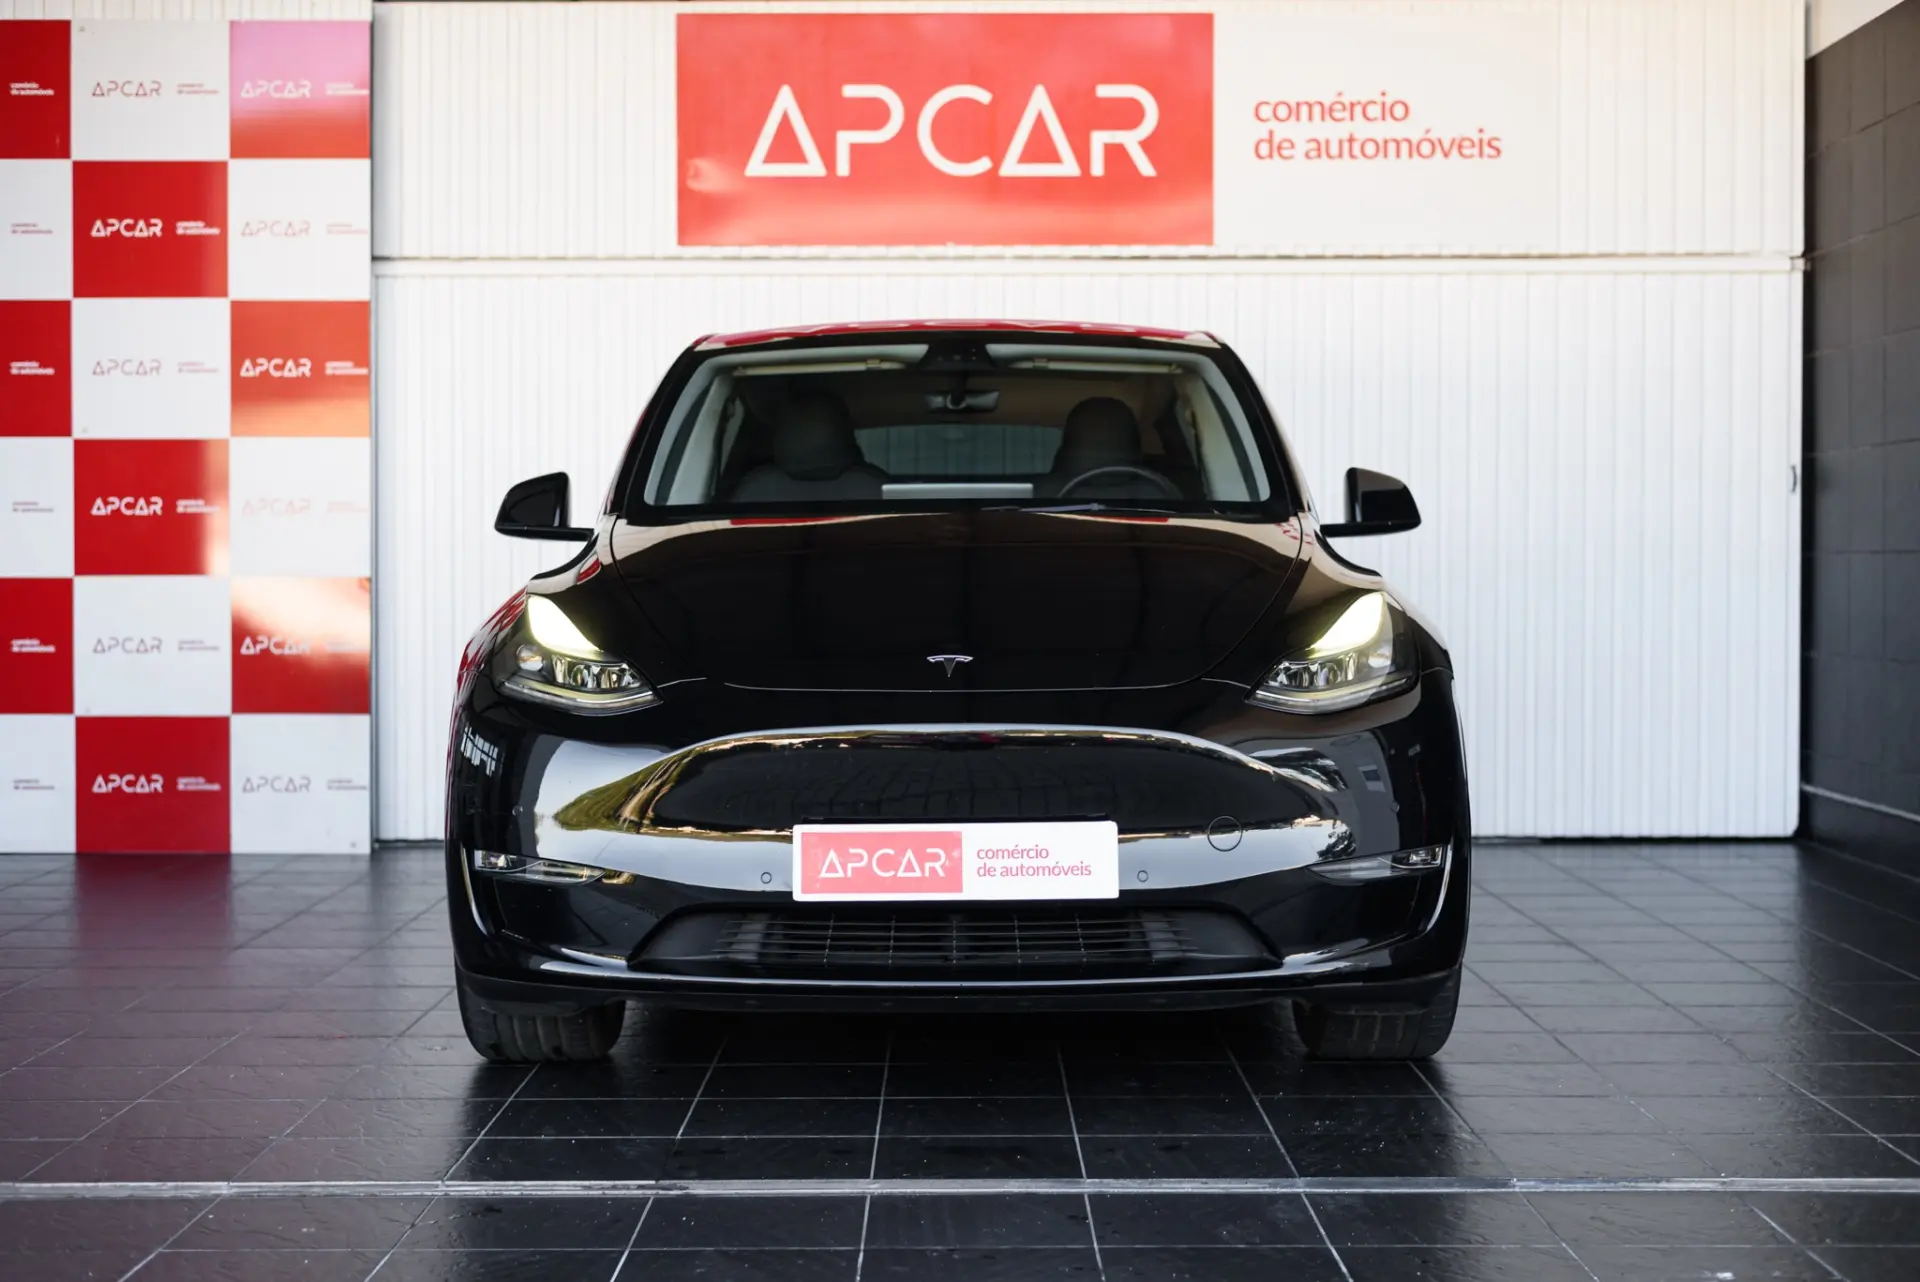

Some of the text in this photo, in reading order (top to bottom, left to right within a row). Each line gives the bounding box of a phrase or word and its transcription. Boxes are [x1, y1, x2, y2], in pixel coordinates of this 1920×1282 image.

[92, 80, 162, 97] APCAR
[241, 79, 312, 98] APCAR
[1254, 91, 1410, 122] comércio
[745, 84, 1159, 177] APCAR
[1254, 128, 1502, 160] de automóveis
[90, 218, 163, 238] APCAR
[241, 219, 311, 237] APCAR
[92, 358, 162, 376] APCAR
[239, 357, 312, 377] APCAR
[90, 496, 163, 516] APCAR
[93, 636, 163, 654] APCAR
[92, 774, 164, 793] APCAR
[242, 776, 311, 793] APCAR
[976, 844, 1049, 860] comércio
[818, 848, 947, 878] APCAR
[976, 860, 1092, 877] de automóveis
